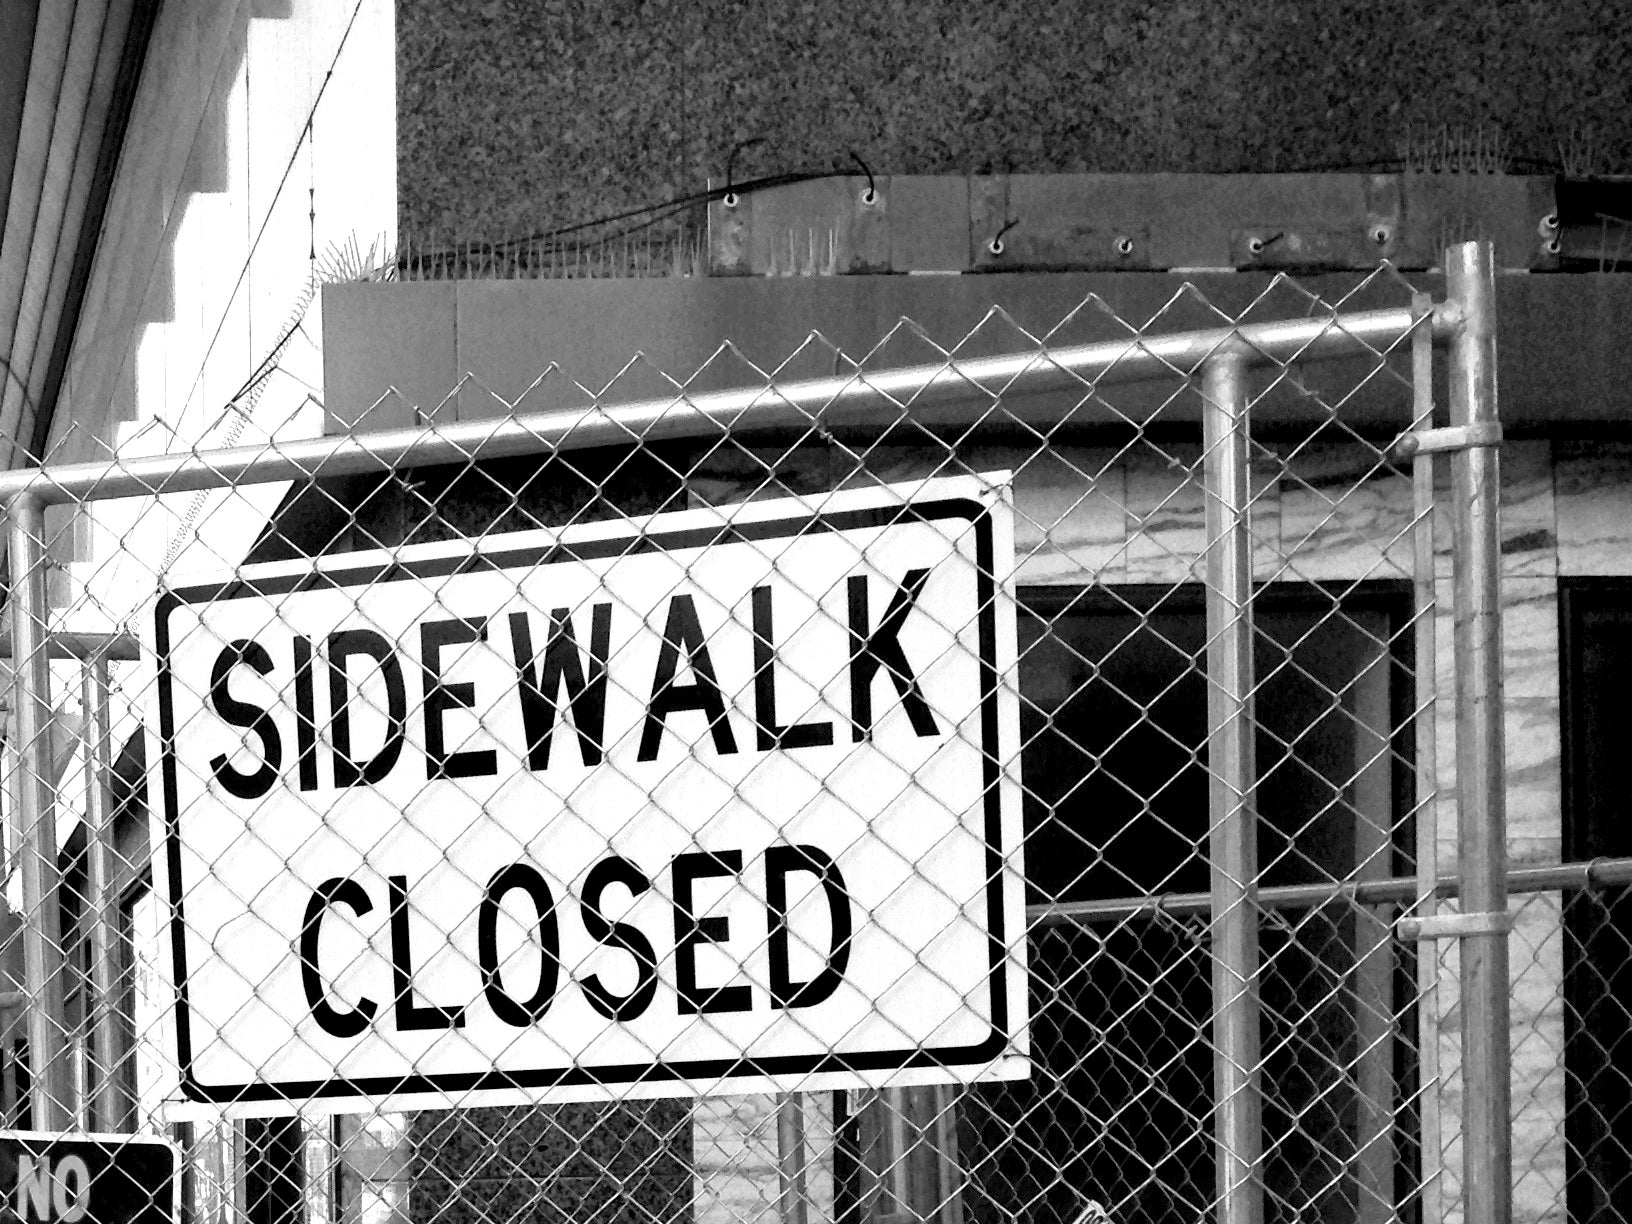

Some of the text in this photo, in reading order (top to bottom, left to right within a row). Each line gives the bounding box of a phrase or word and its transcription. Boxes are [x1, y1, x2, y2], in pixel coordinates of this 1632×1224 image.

[207, 567, 942, 800] SIDEWALK
[300, 843, 853, 1039] CLOSED
[18, 1155, 91, 1224] NO
